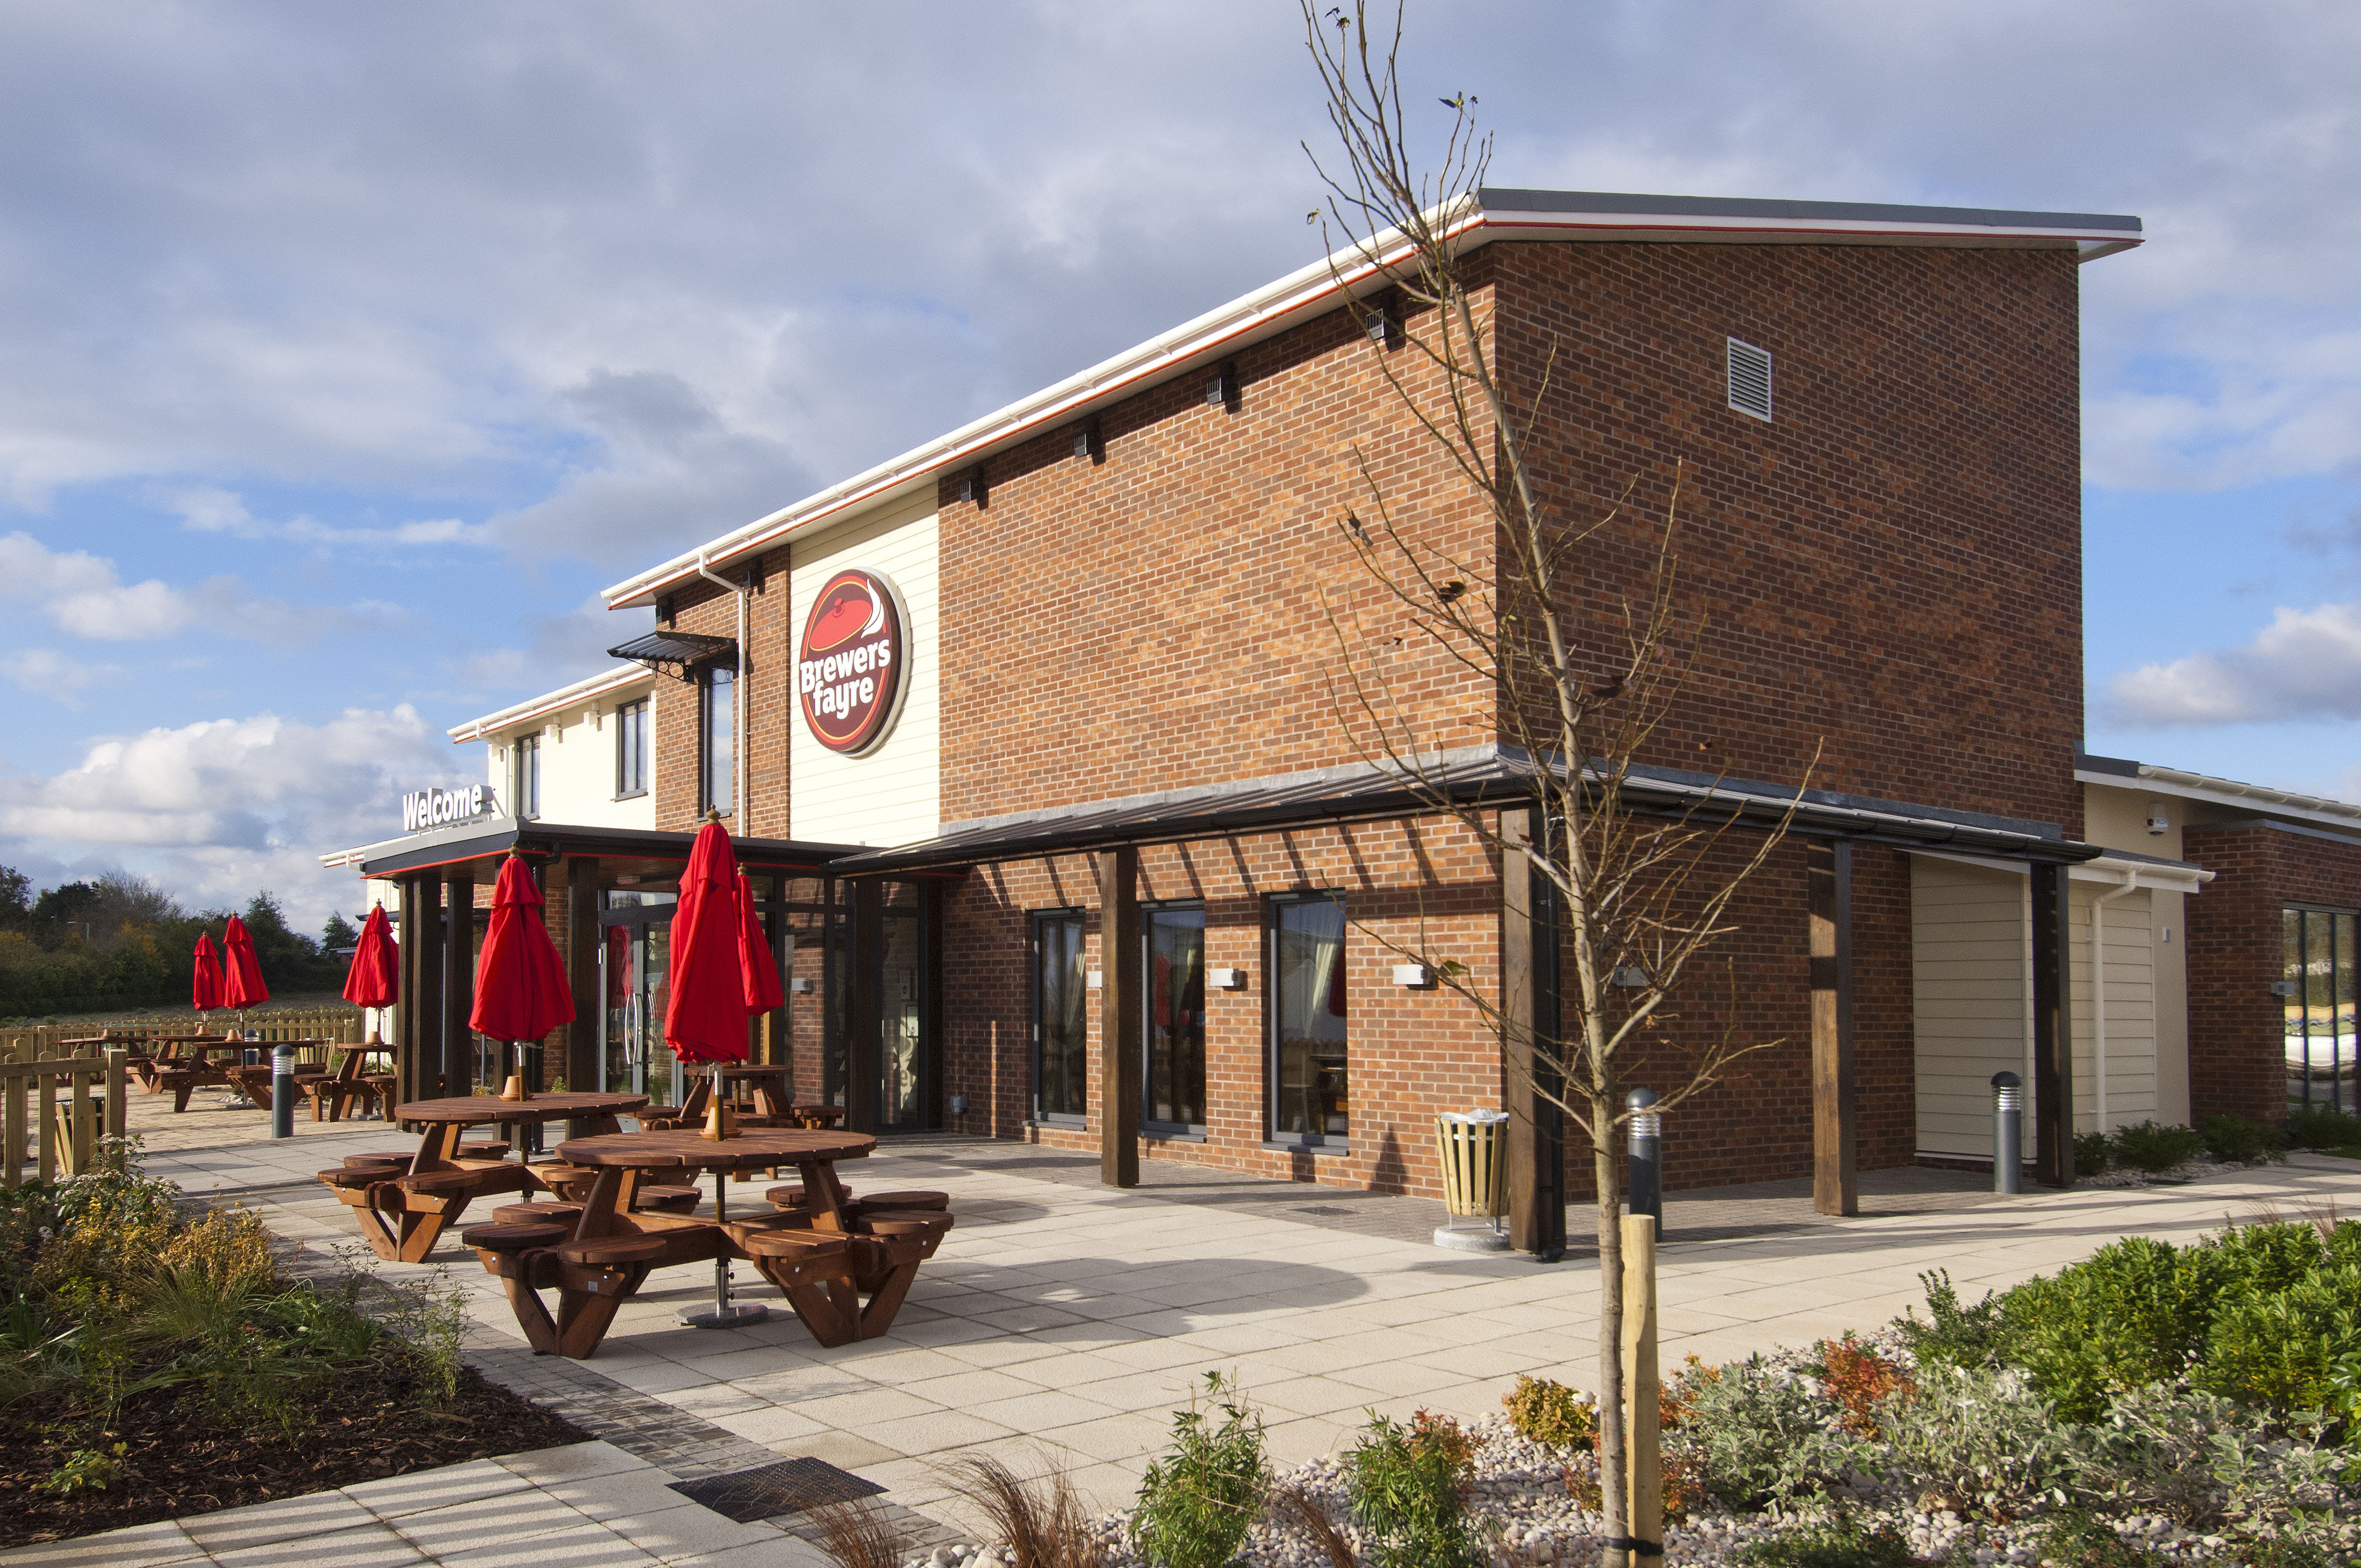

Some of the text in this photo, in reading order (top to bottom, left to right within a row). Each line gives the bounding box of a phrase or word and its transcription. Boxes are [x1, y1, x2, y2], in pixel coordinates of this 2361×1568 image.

[800, 639, 890, 694] Brewers
[813, 677, 873, 719] fayre
[403, 784, 482, 831] Welcome
